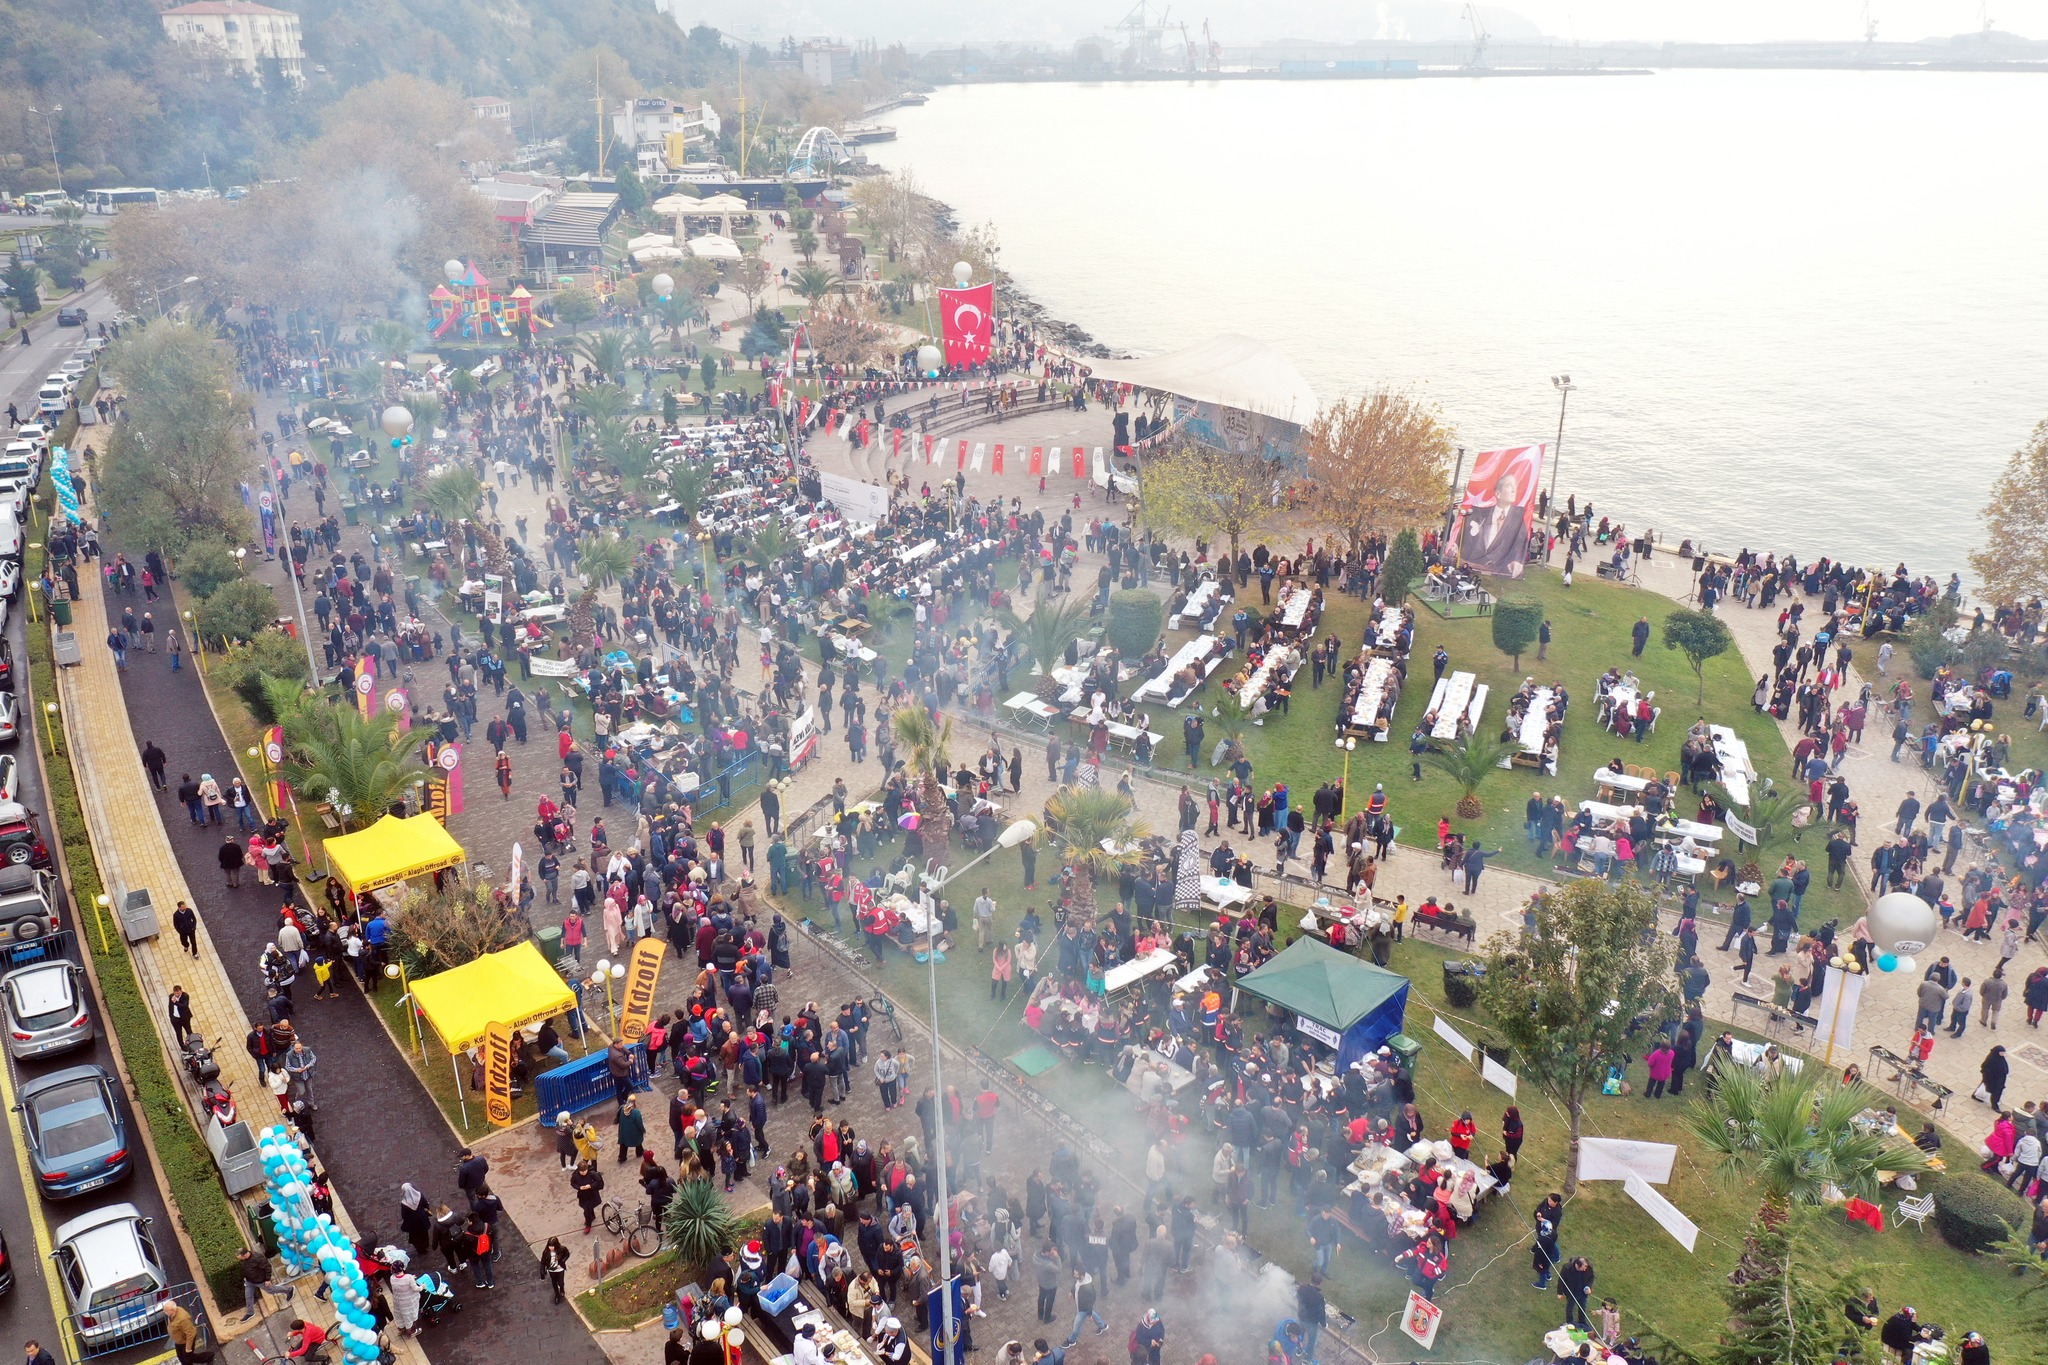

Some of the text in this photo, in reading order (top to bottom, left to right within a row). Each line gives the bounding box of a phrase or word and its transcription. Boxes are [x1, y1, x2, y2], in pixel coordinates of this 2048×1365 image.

[424, 859, 448, 871] Offroad
[627, 950, 660, 1016] Kdzoff
[532, 1006, 558, 1021] Offroad
[1312, 1021, 1327, 1034] TRAC
[489, 1031, 508, 1098] Kdzoff
